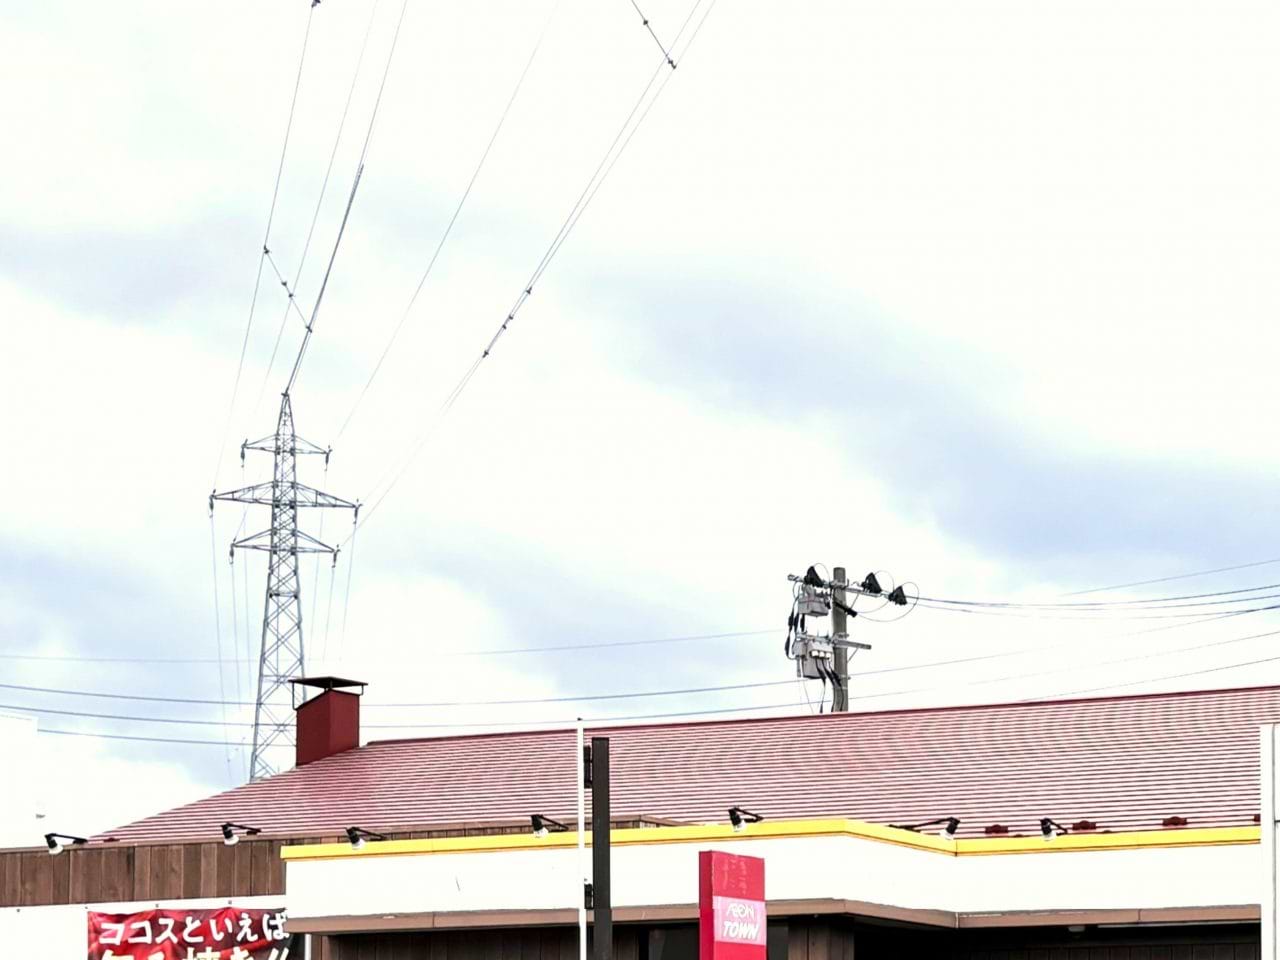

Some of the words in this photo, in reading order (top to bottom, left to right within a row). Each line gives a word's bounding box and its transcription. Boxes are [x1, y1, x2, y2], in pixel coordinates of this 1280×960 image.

[100, 913, 290, 945] ココスといえば
[722, 920, 759, 940] TOWN
